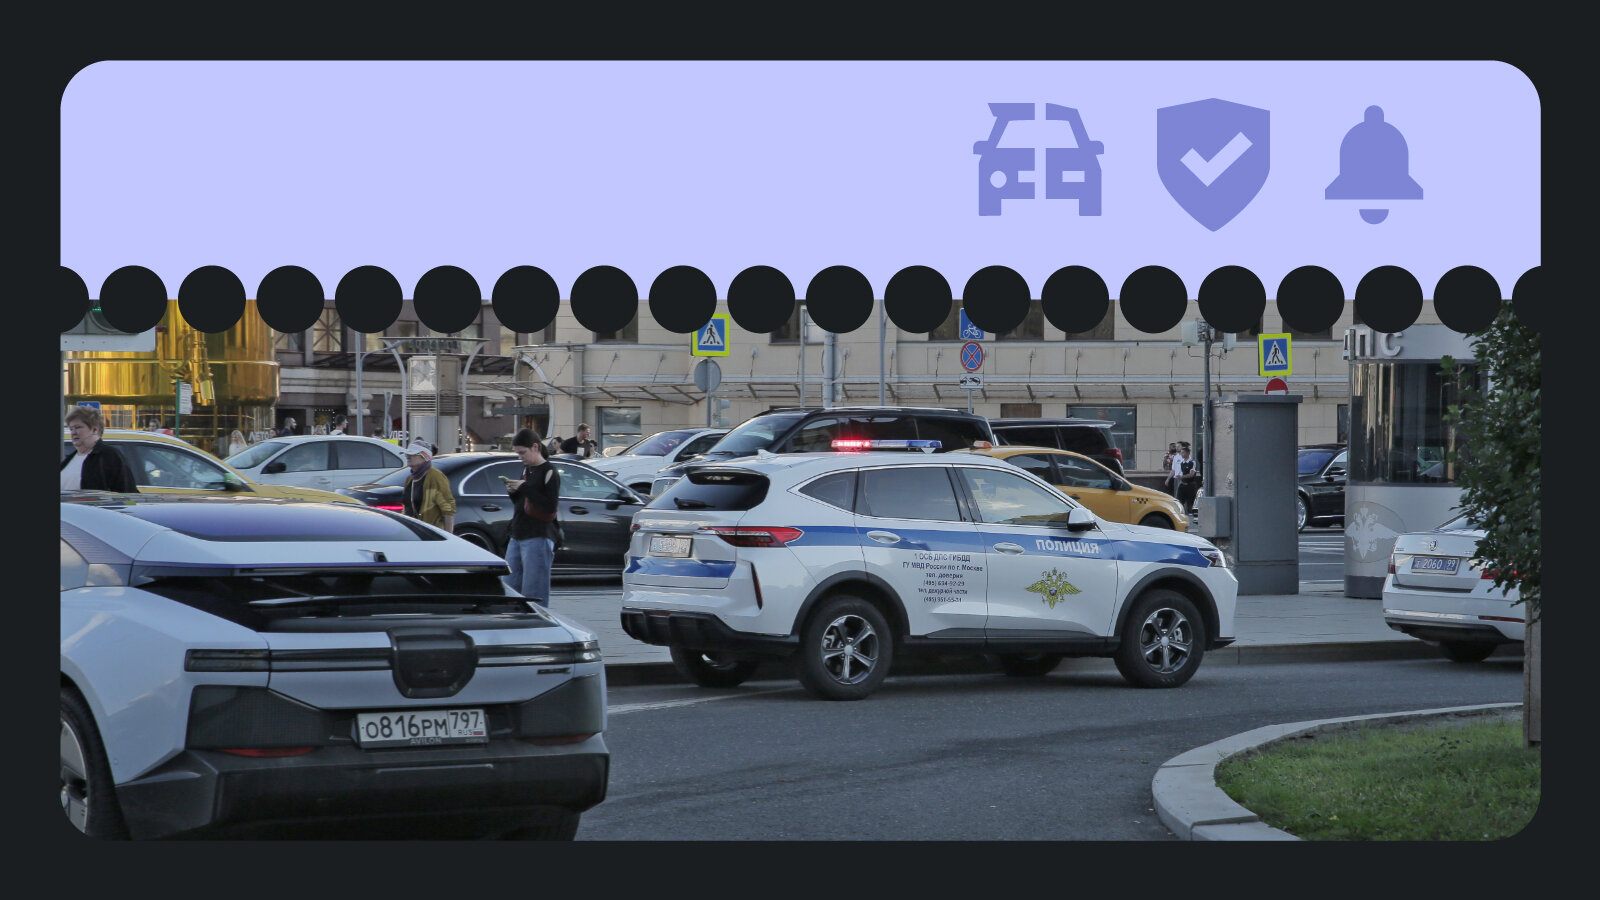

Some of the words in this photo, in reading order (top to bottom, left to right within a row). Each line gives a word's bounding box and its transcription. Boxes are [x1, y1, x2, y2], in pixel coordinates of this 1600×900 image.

[1343, 327, 1402, 360] ДПС
[1036, 539, 1099, 554] ПОЛИЦИЯ
[949, 554, 971, 562] ГИБДД
[1422, 559, 1443, 570] 2060
[1446, 560, 1456, 568] 99
[911, 562, 925, 570] МВД
[449, 711, 479, 730] 797
